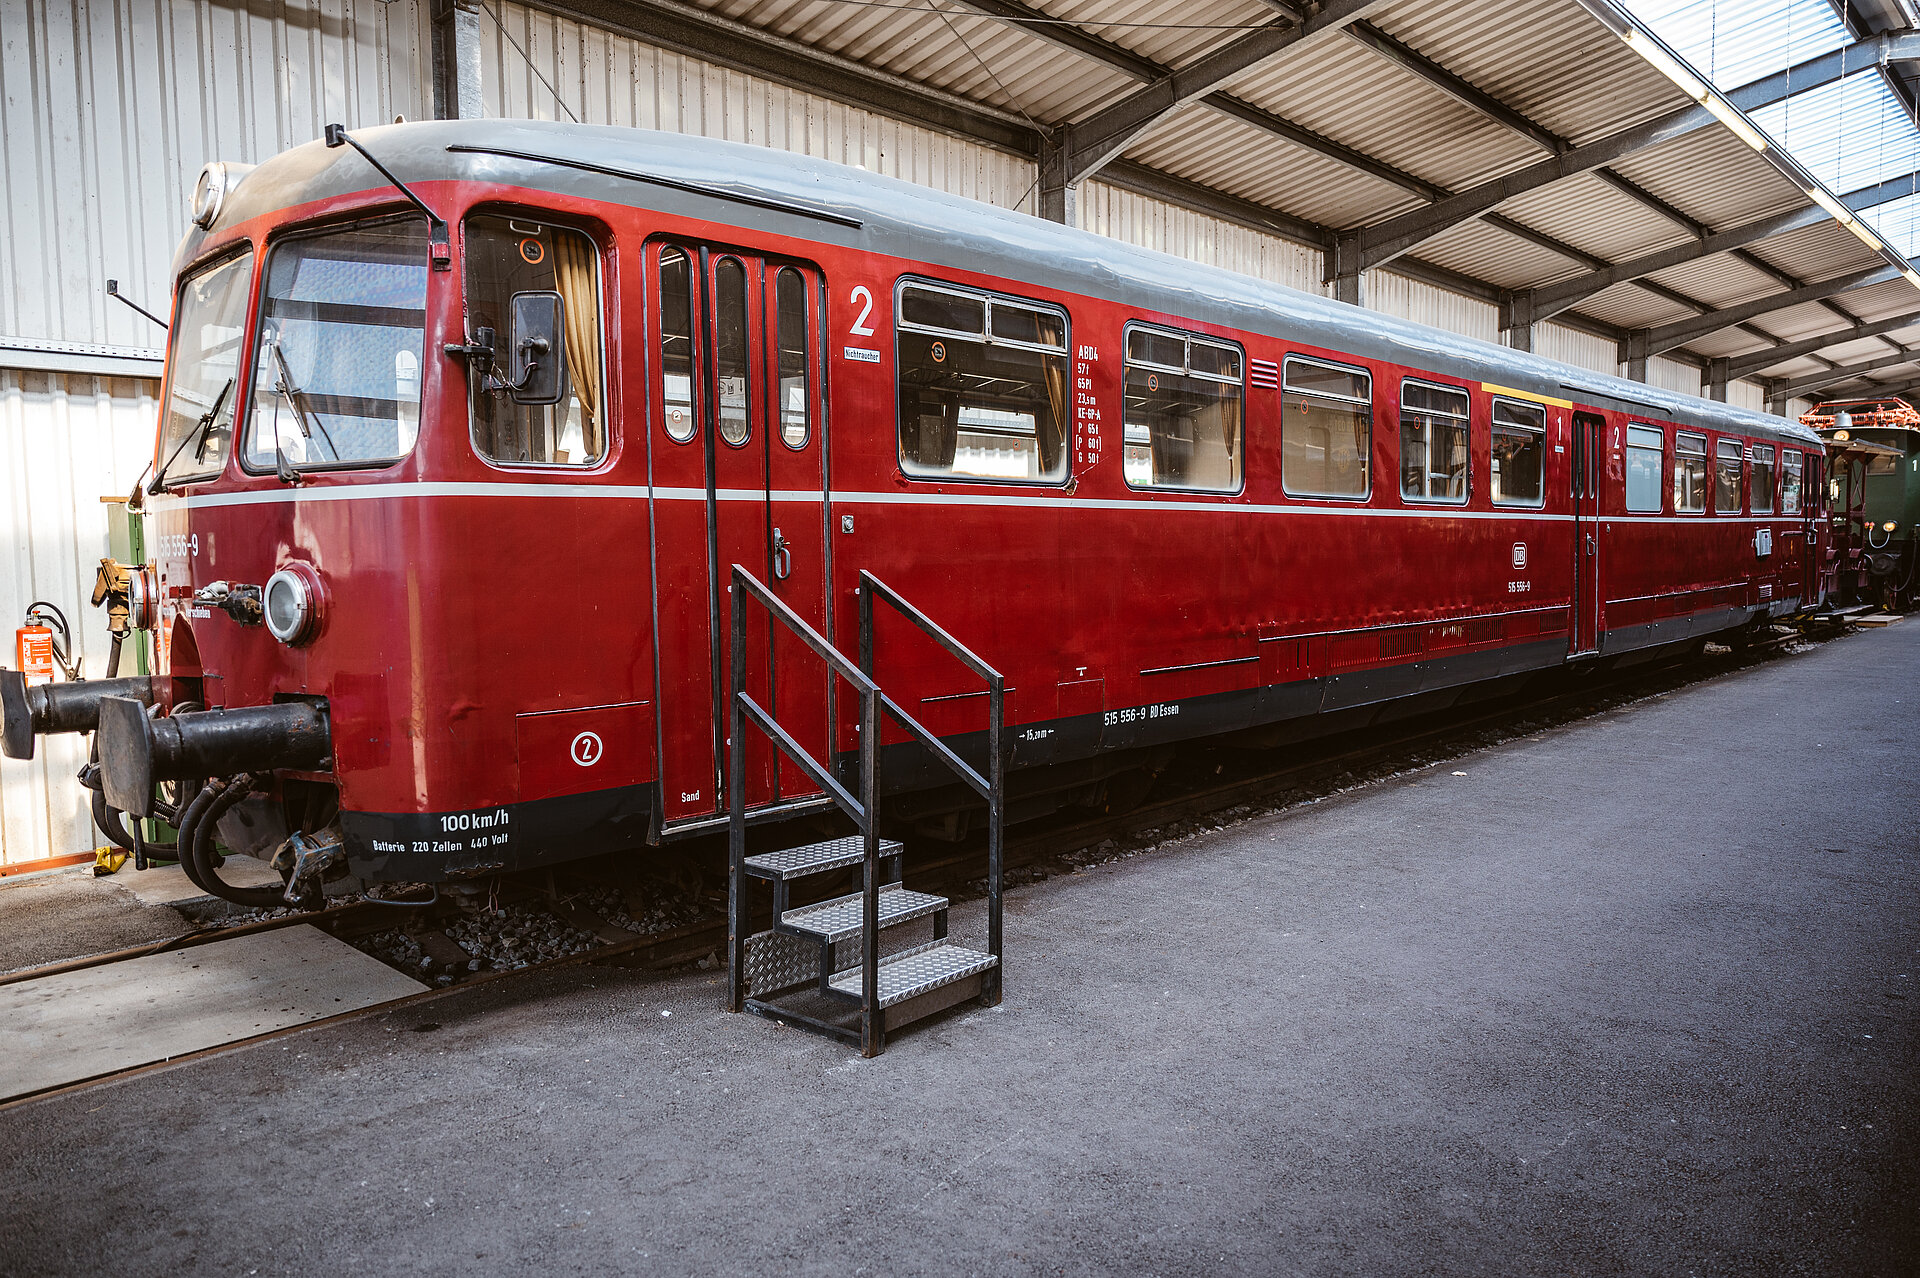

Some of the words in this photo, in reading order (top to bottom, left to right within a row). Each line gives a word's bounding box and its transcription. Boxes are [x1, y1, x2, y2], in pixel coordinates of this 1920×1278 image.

[850, 285, 875, 336] 2
[845, 348, 879, 362] Nichtraucher
[1078, 344, 1099, 362] ABD4
[1078, 421, 1083, 434] P
[1557, 416, 1562, 441] 1
[1613, 426, 1620, 449] 2
[172, 533, 199, 557] 556-9
[1104, 711, 1118, 727] 515
[1120, 707, 1146, 724] 556-9
[1159, 704, 1179, 717] Essen
[582, 738, 592, 760] 2
[681, 790, 700, 803] Sand
[440, 814, 470, 833] 100
[472, 808, 509, 830] km/h
[372, 840, 406, 852] Batterie
[412, 841, 429, 853] 220
[432, 840, 463, 853] Zellen
[470, 836, 488, 849] 440
[491, 833, 509, 846] Volt
